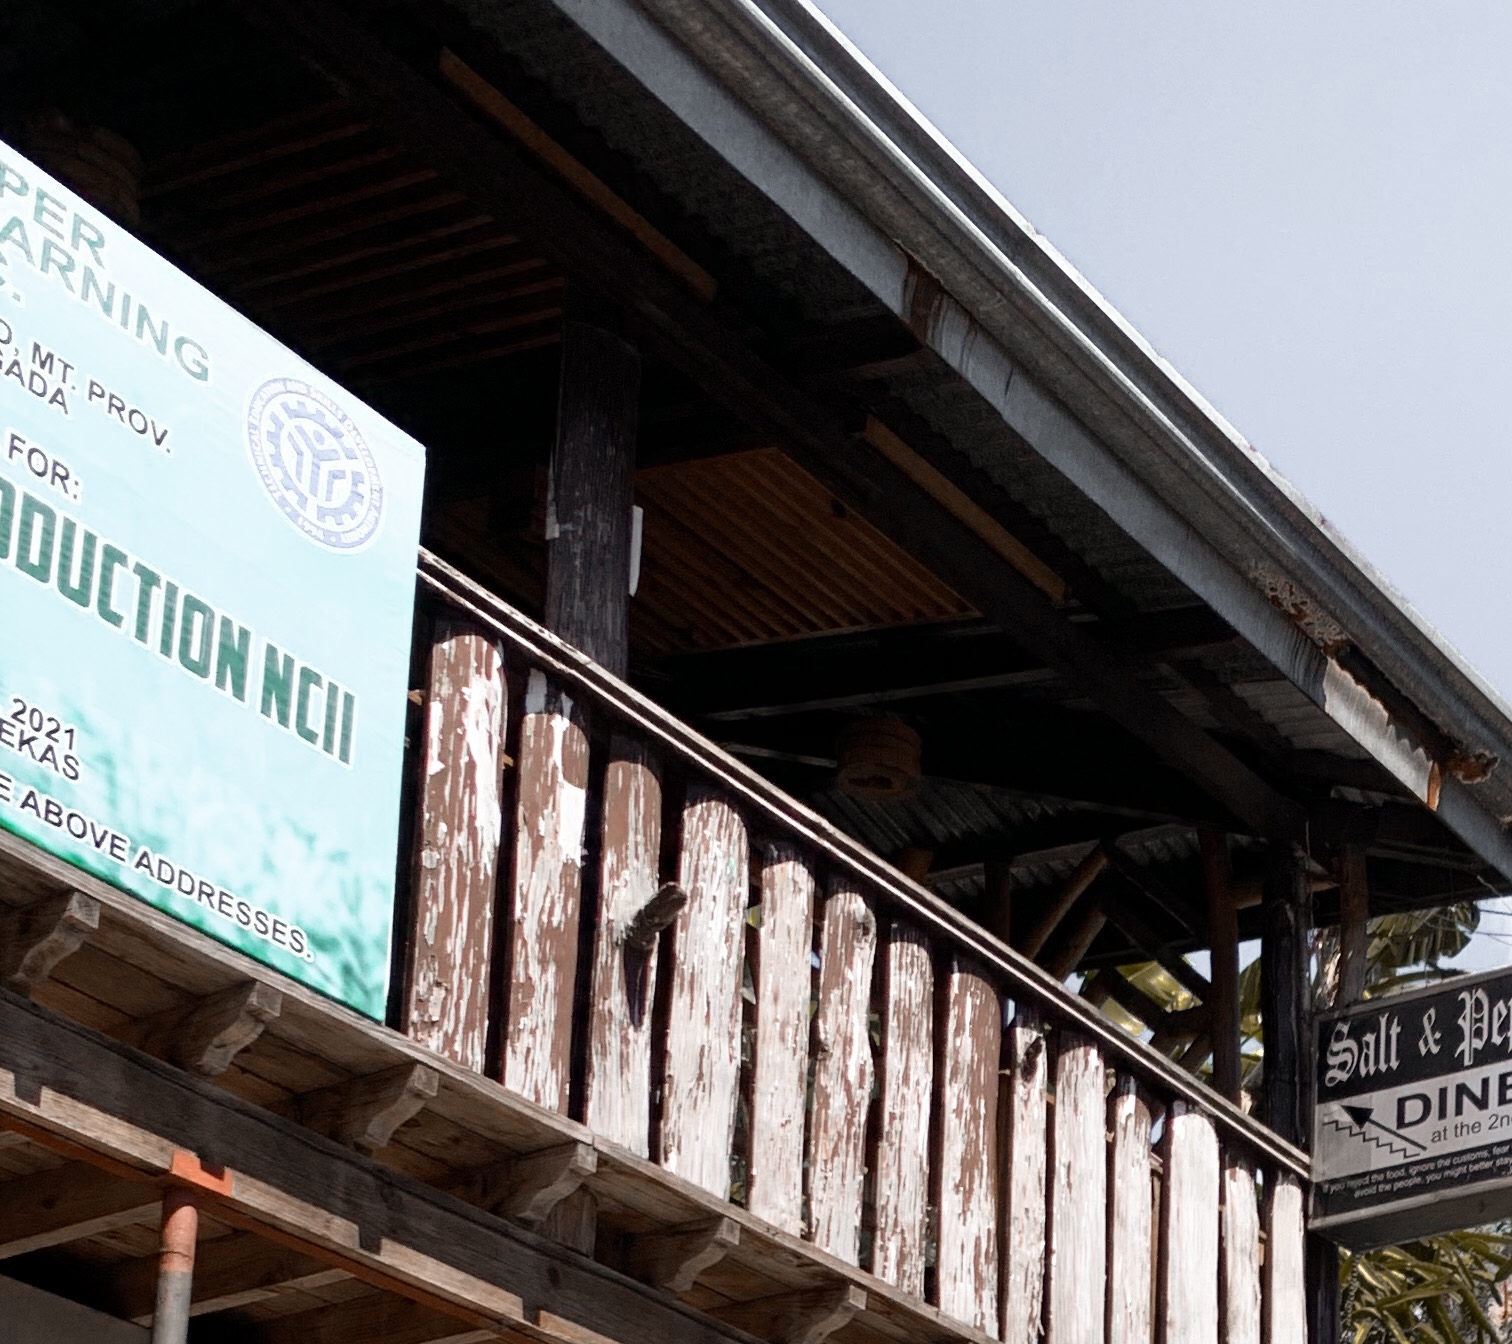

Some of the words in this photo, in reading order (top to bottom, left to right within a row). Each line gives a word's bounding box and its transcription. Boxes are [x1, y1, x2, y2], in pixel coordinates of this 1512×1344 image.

[0, 216, 209, 382] ARNING
[0, 360, 68, 415] ADA
[31, 342, 76, 390] MT.
[88, 379, 171, 453] PROV.
[8, 433, 79, 500] FOR:
[10, 698, 75, 751] 2021
[260, 641, 355, 766] NCII
[0, 719, 80, 781] EKAS
[20, 790, 127, 862] ABOVE
[135, 850, 312, 959] ADDRESSES.
[1325, 1012, 1401, 1087] Salt
[1418, 1006, 1442, 1057] &
[1430, 1123, 1451, 1145] at
[1454, 1118, 1482, 1139] the
